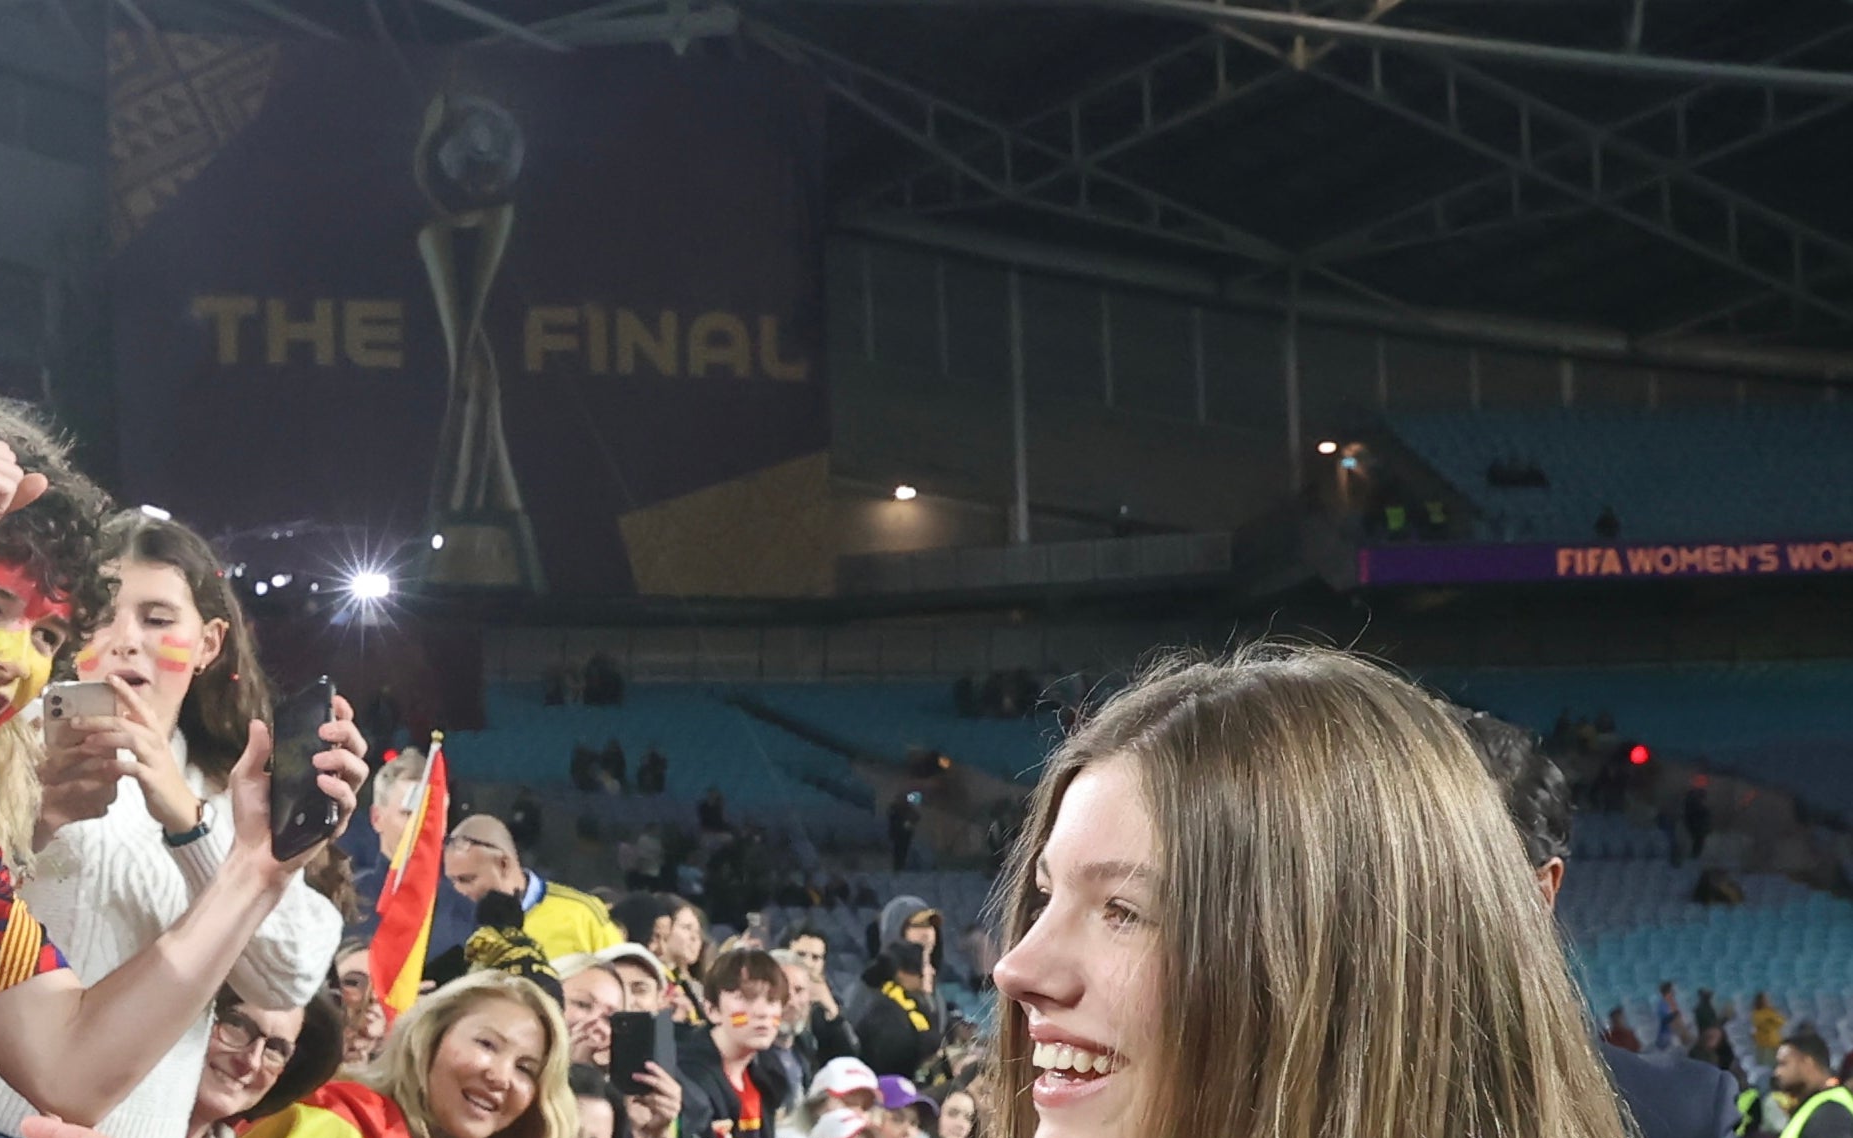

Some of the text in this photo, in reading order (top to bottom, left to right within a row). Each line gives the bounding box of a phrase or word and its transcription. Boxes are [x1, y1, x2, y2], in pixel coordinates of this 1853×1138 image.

[192, 297, 809, 381] THE FINAL
[1556, 546, 1622, 576] FIFA
[1625, 542, 1779, 575] WOMEN'S
